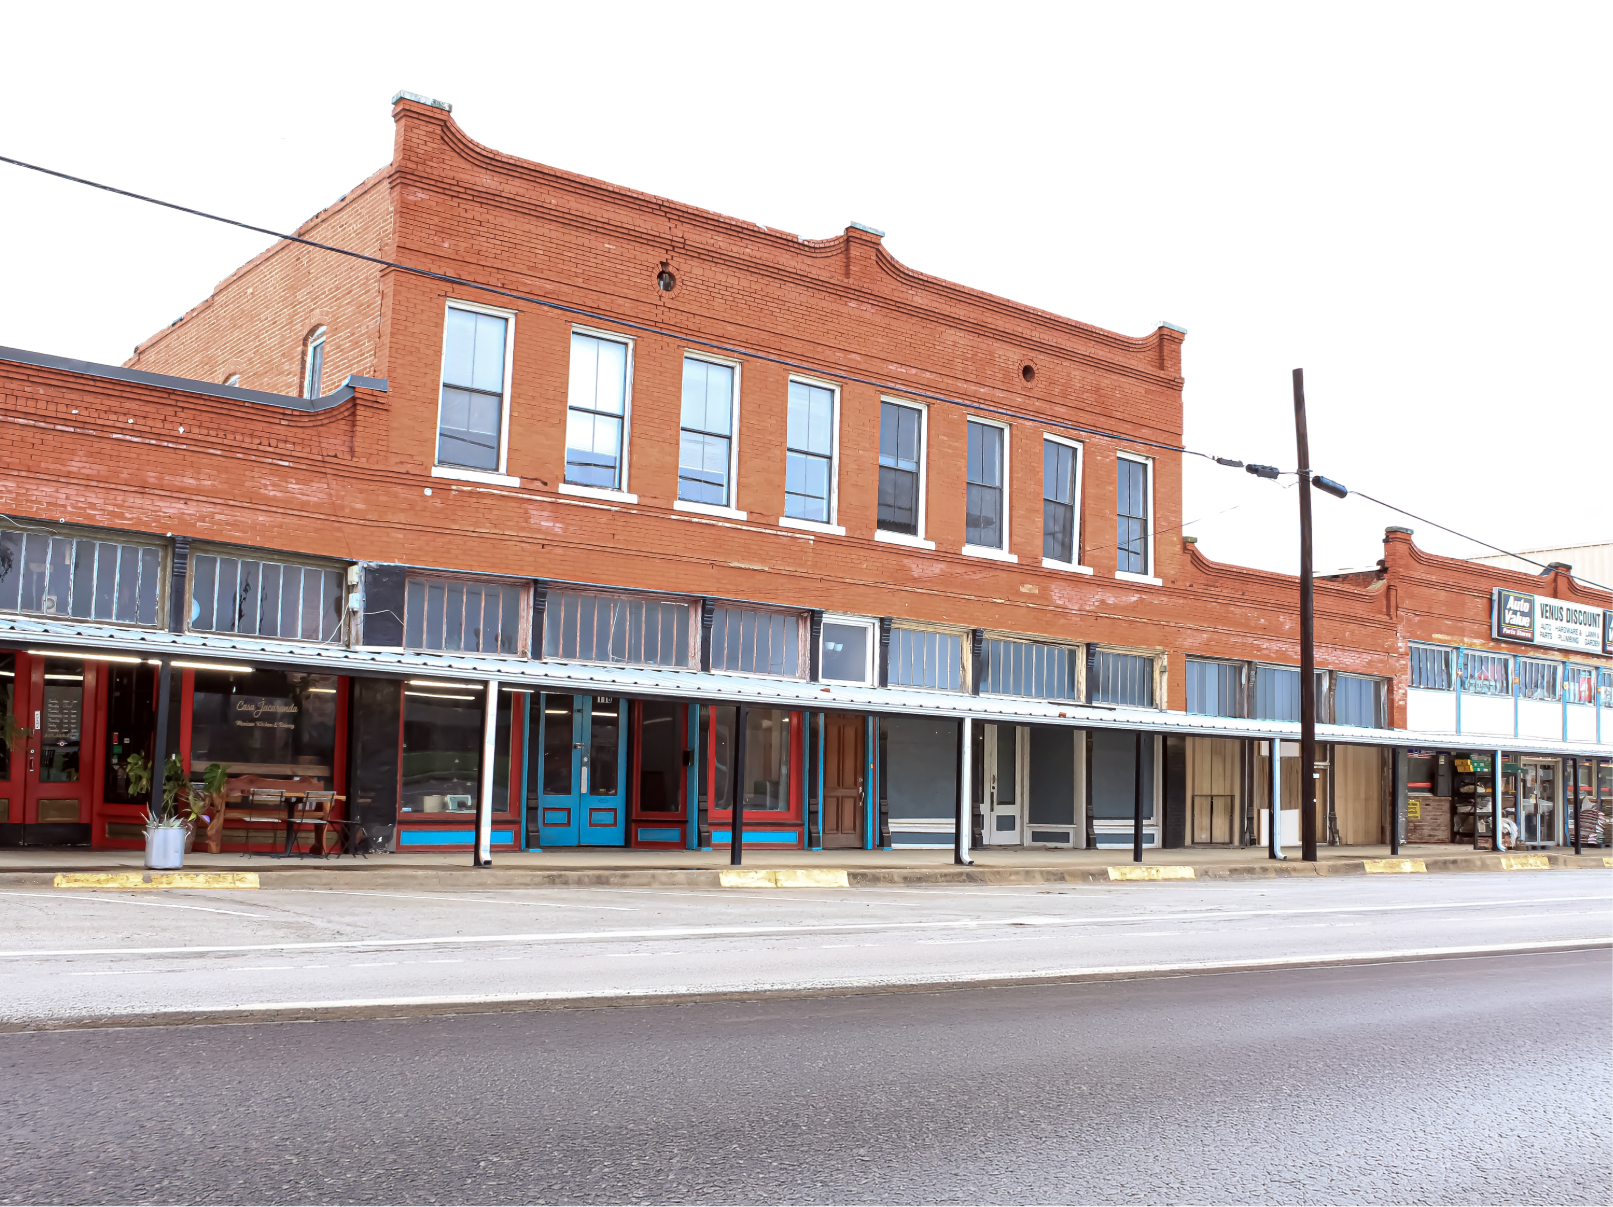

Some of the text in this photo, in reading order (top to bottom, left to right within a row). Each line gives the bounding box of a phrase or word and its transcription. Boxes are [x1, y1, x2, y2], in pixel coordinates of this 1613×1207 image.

[1506, 595, 1530, 613] Auto
[1505, 609, 1531, 627] Value
[1540, 603, 1564, 622] VENUS
[1566, 608, 1601, 628] DISCOUNT
[1540, 623, 1552, 631] AUTO
[1555, 626, 1578, 635] HARDWARE
[1540, 631, 1552, 639] PARTS
[1558, 634, 1579, 644] PLUMBING
[1584, 639, 1600, 647] GARDEN
[236, 698, 298, 718] Casa Jacaranda
